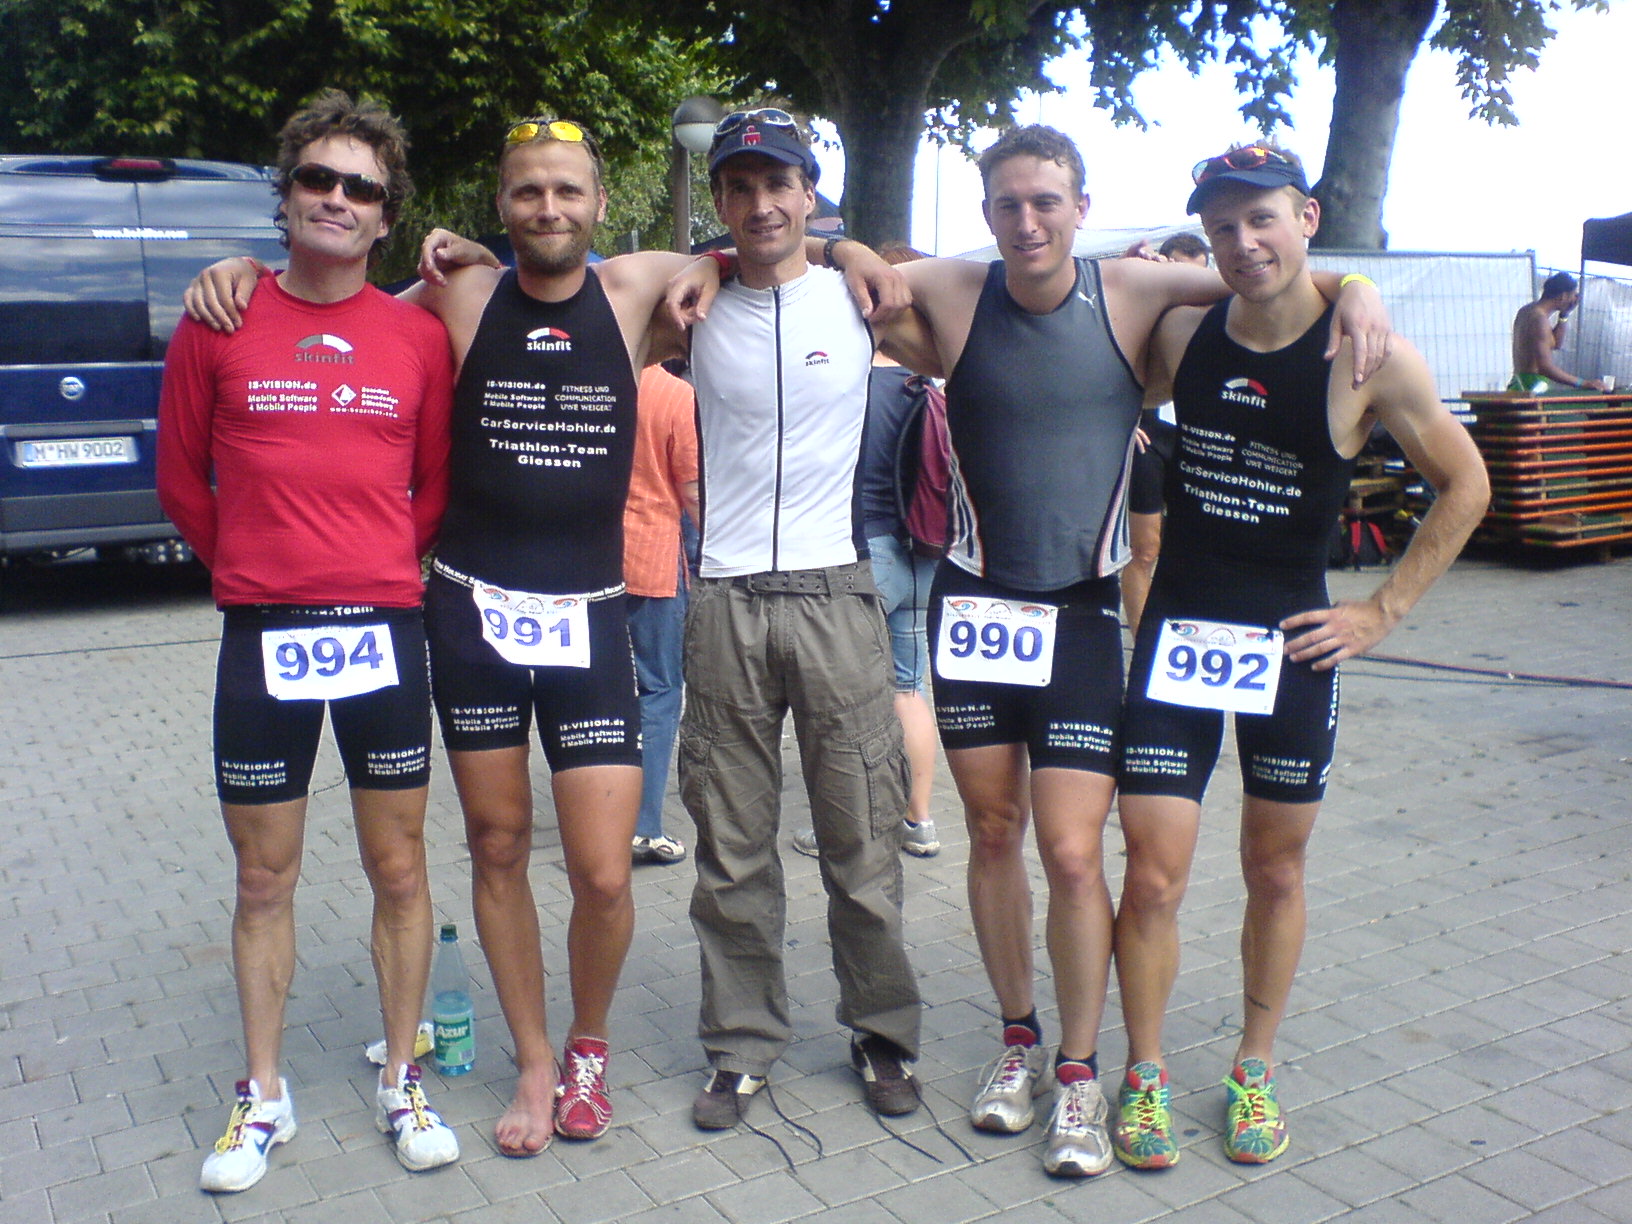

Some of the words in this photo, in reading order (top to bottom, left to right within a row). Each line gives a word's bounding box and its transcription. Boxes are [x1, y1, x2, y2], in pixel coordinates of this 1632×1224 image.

[526, 340, 572, 351] skinfit
[294, 352, 355, 364] skinfit
[248, 380, 318, 390] IS-VISION.de
[486, 380, 546, 390] IS-VISION.de
[561, 385, 593, 394] FITNESS
[595, 385, 610, 393] UND
[247, 393, 277, 403] Mobile
[279, 393, 318, 403] Software
[484, 392, 508, 401] Mobile
[510, 393, 546, 402] Software
[554, 394, 617, 403] COMMUNICATION
[1221, 390, 1268, 409] skinfit
[248, 404, 254, 412] 4
[256, 403, 285, 412] Mobile
[287, 403, 318, 413] People
[489, 400, 515, 409] Mobile
[516, 402, 546, 411] People
[560, 403, 579, 411] UWE
[580, 404, 613, 412] WEIGERT
[480, 417, 617, 434] CarServiceHohler.de
[82, 441, 123, 458] 9002
[489, 438, 608, 455] Triathlon-Team
[1201, 442, 1235, 454] Software
[1249, 440, 1279, 456] FITNESS
[517, 454, 582, 468] Giessen
[1207, 451, 1233, 462] People
[1241, 448, 1304, 470] COMMUNICATION
[1245, 459, 1262, 470] UWE
[1264, 461, 1298, 477] WEIGERT
[1180, 460, 1302, 497] CarServiceHohler.de
[1183, 482, 1290, 515] Triathlon-Team
[1202, 502, 1260, 524] Giessen
[483, 608, 571, 648] 991
[950, 620, 1043, 662] 990
[275, 630, 384, 681] 994
[1166, 645, 1269, 691] 992
[450, 705, 518, 715] IS-VISION.de
[453, 718, 481, 726] Mobile
[484, 715, 519, 725] Software
[461, 724, 491, 732] Mobile
[493, 721, 520, 731] People
[559, 718, 625, 732] IS-VISION.de
[1049, 722, 1114, 736] IS-VISION.de
[560, 732, 586, 742] Mobile
[588, 730, 625, 738] Software
[567, 739, 594, 748] Mobile
[595, 736, 625, 744] People
[1048, 733, 1075, 741] Mobile
[1077, 734, 1112, 746] Software
[367, 746, 426, 760] IS-VISION.de
[1054, 740, 1082, 749] Mobile
[1083, 742, 1111, 754] People
[1126, 746, 1188, 758] IS-VISION.de
[221, 760, 286, 771] IS-VISION.de
[367, 761, 393, 769] Mobile
[395, 756, 426, 769] Software
[1125, 758, 1151, 766] Mobile
[1153, 759, 1188, 769] Software
[222, 771, 247, 780] Mobile
[250, 771, 286, 780] Software
[374, 767, 401, 776] Mobile
[1131, 766, 1159, 774] Mobile
[1160, 767, 1188, 776] People
[229, 778, 256, 787] Mobile
[259, 778, 287, 787] People
[435, 1024, 469, 1040] Azur
